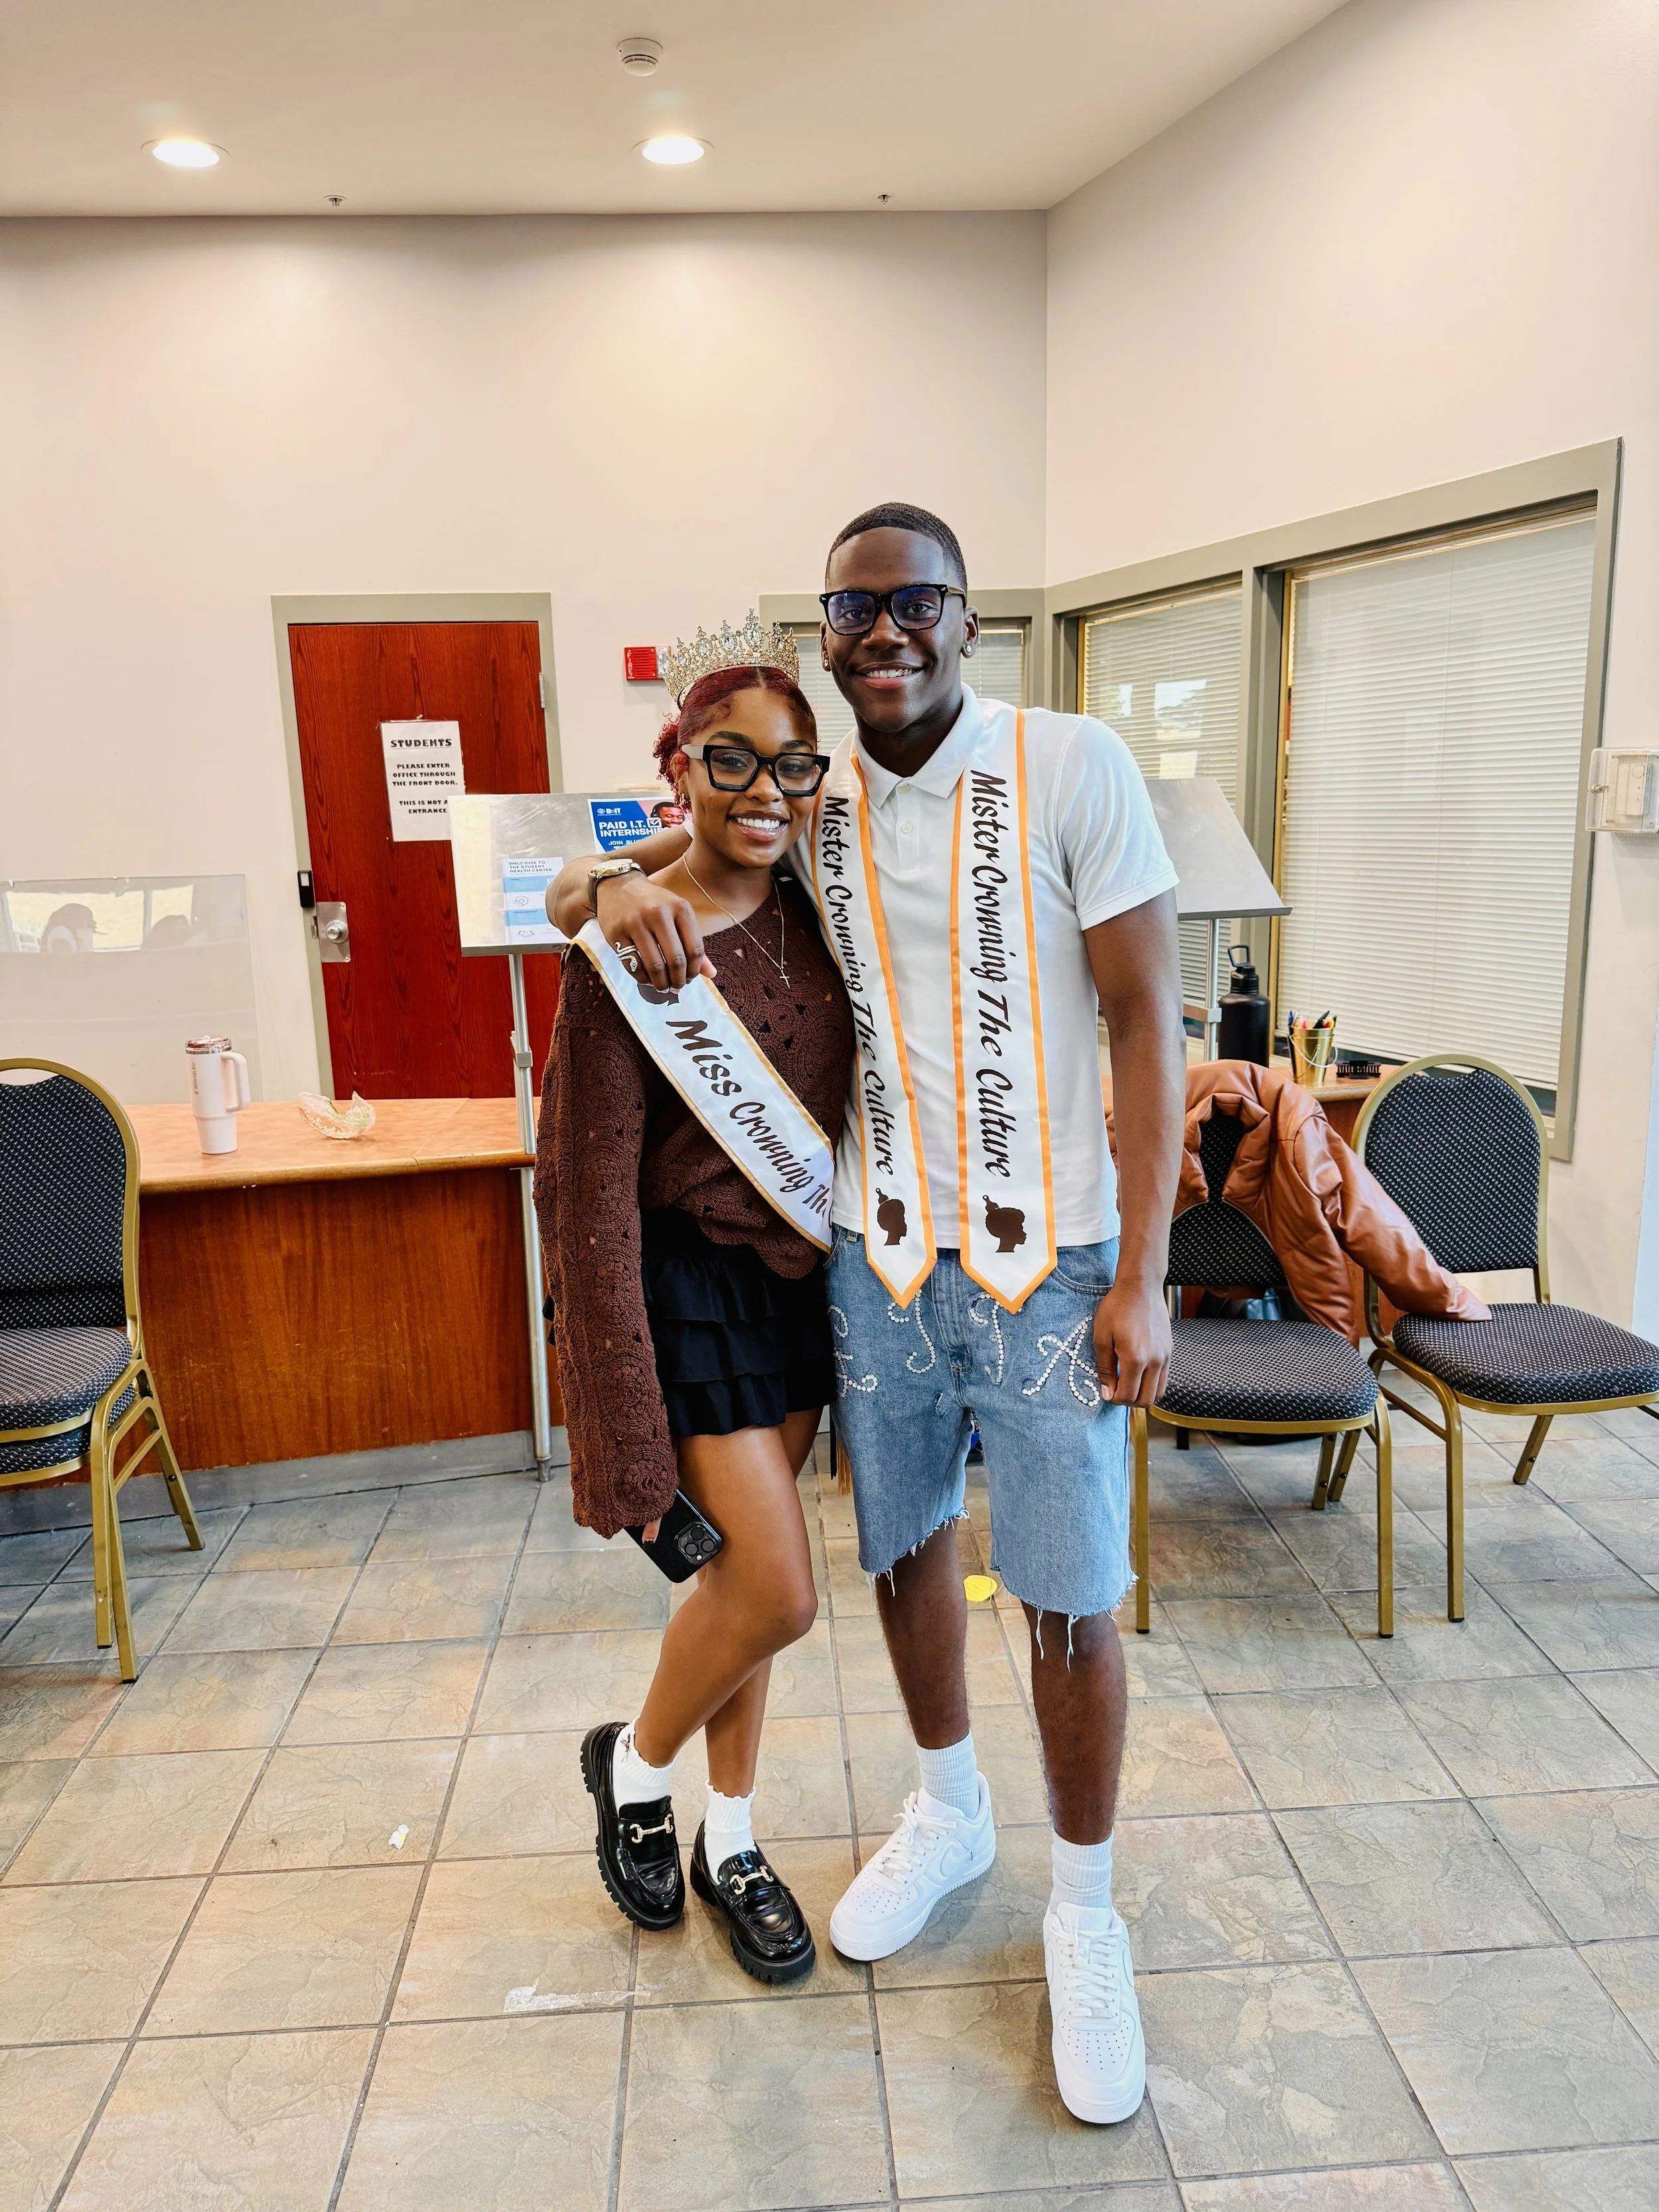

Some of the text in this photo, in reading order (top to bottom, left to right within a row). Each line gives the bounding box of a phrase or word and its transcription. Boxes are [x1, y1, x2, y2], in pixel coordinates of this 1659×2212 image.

[390, 739, 453, 747] STUDENTS
[599, 821, 627, 830] PAID
[600, 827, 669, 838] INTERNSHIP
[822, 796, 895, 1176] Mister Crowning The Culture
[970, 770, 1017, 1177] Mister Crowning The Culture
[666, 1019, 743, 1097] Miss
[729, 1102, 815, 1193] Crowning
